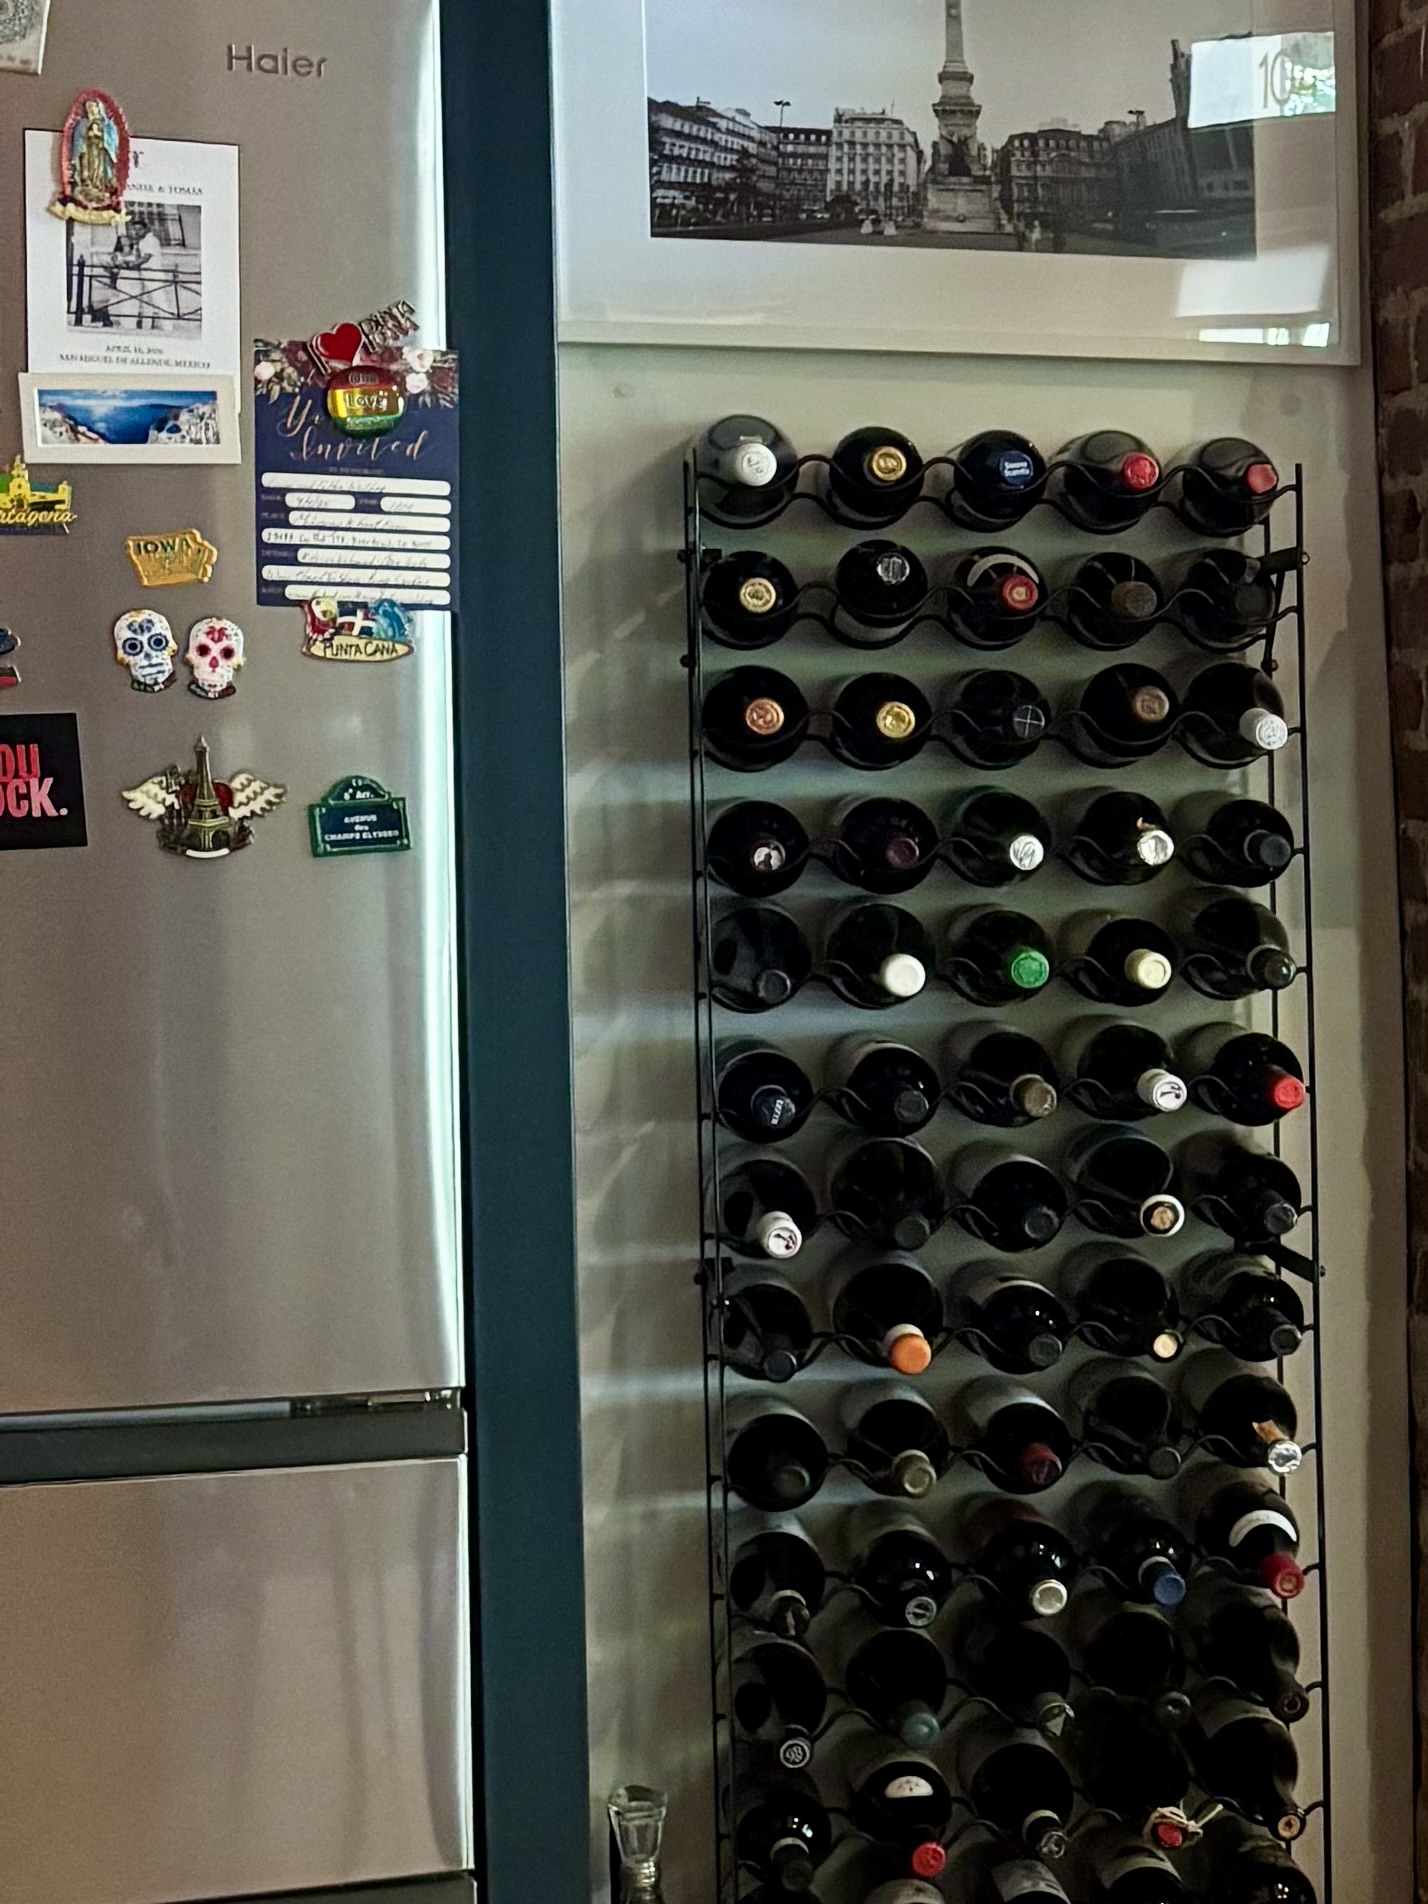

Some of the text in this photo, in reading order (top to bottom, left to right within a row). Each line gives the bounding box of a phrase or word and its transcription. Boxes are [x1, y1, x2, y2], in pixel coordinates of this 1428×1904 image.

[227, 43, 327, 78] Haier
[290, 426, 429, 461] Invited
[138, 536, 194, 555] IOWA
[323, 641, 398, 658] PUNTA CANA
[0, 777, 68, 818] CK.
